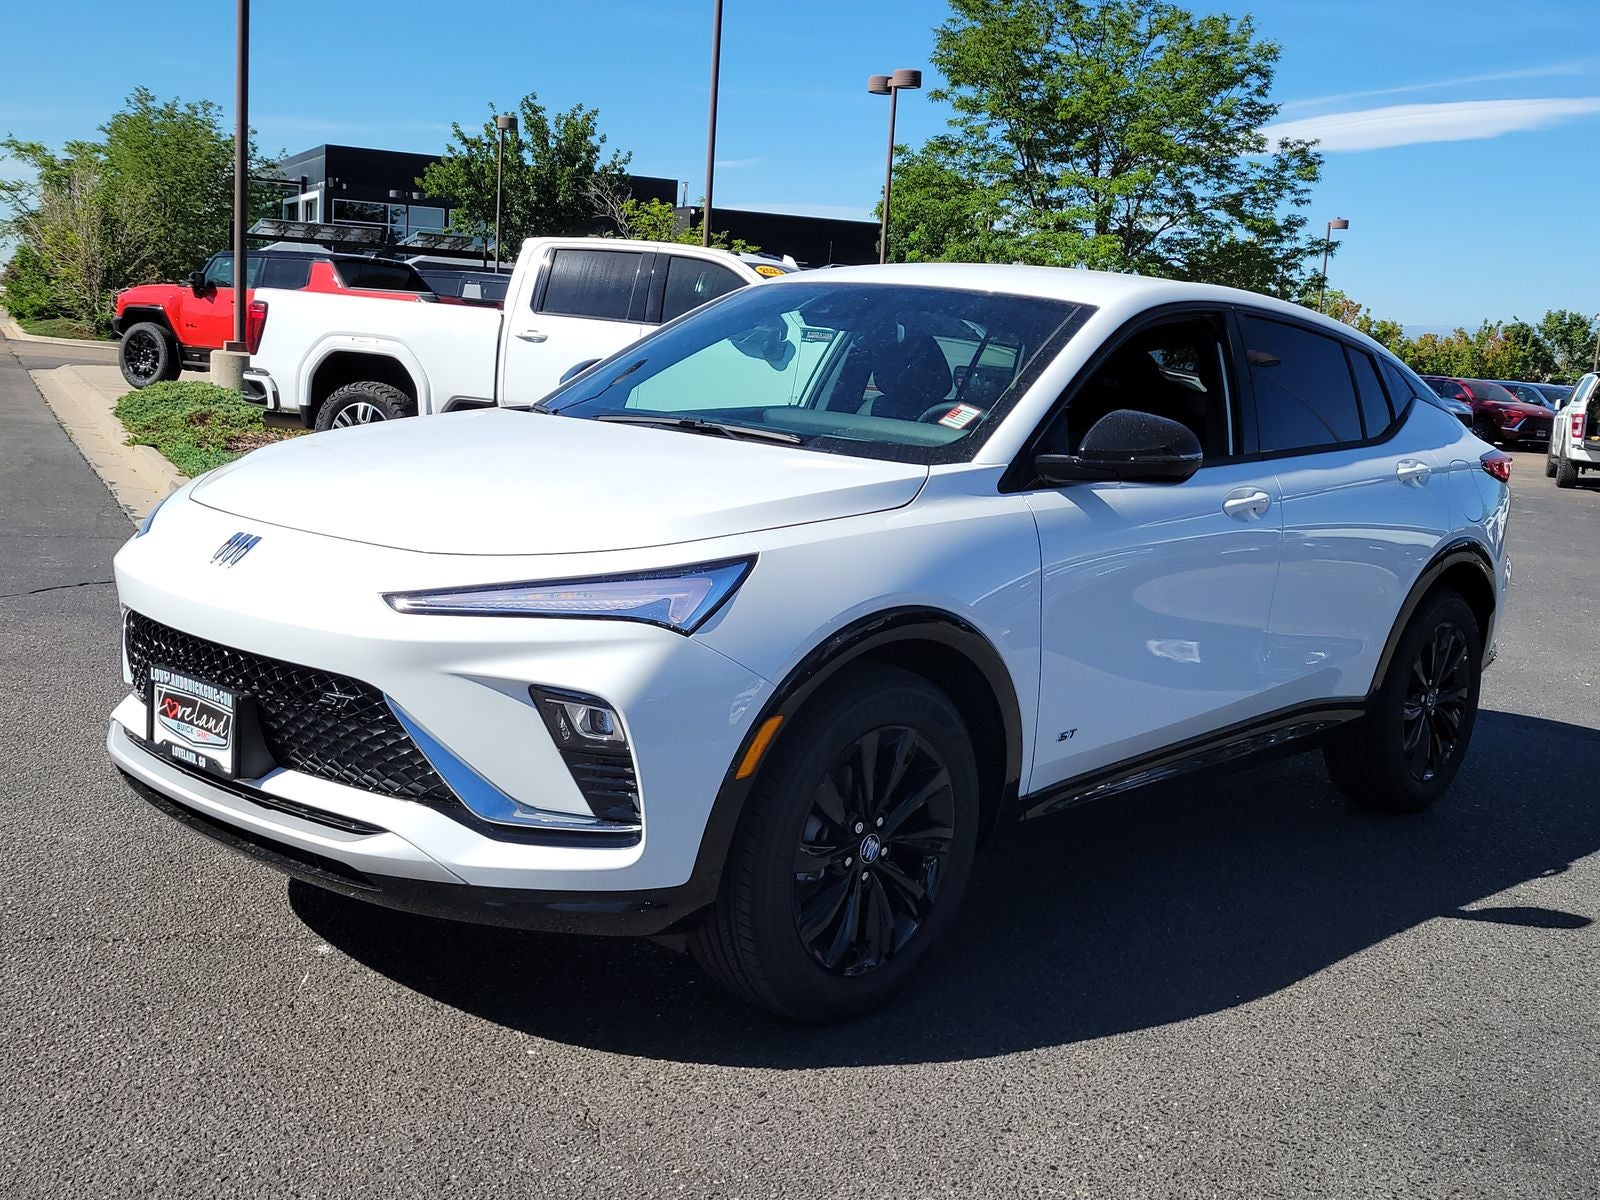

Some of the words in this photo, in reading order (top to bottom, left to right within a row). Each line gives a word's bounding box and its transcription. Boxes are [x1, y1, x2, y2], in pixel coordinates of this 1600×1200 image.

[318, 692, 355, 708] ST
[176, 722, 194, 735] BUICK
[196, 728, 210, 741] GMC
[1056, 728, 1078, 743] ST
